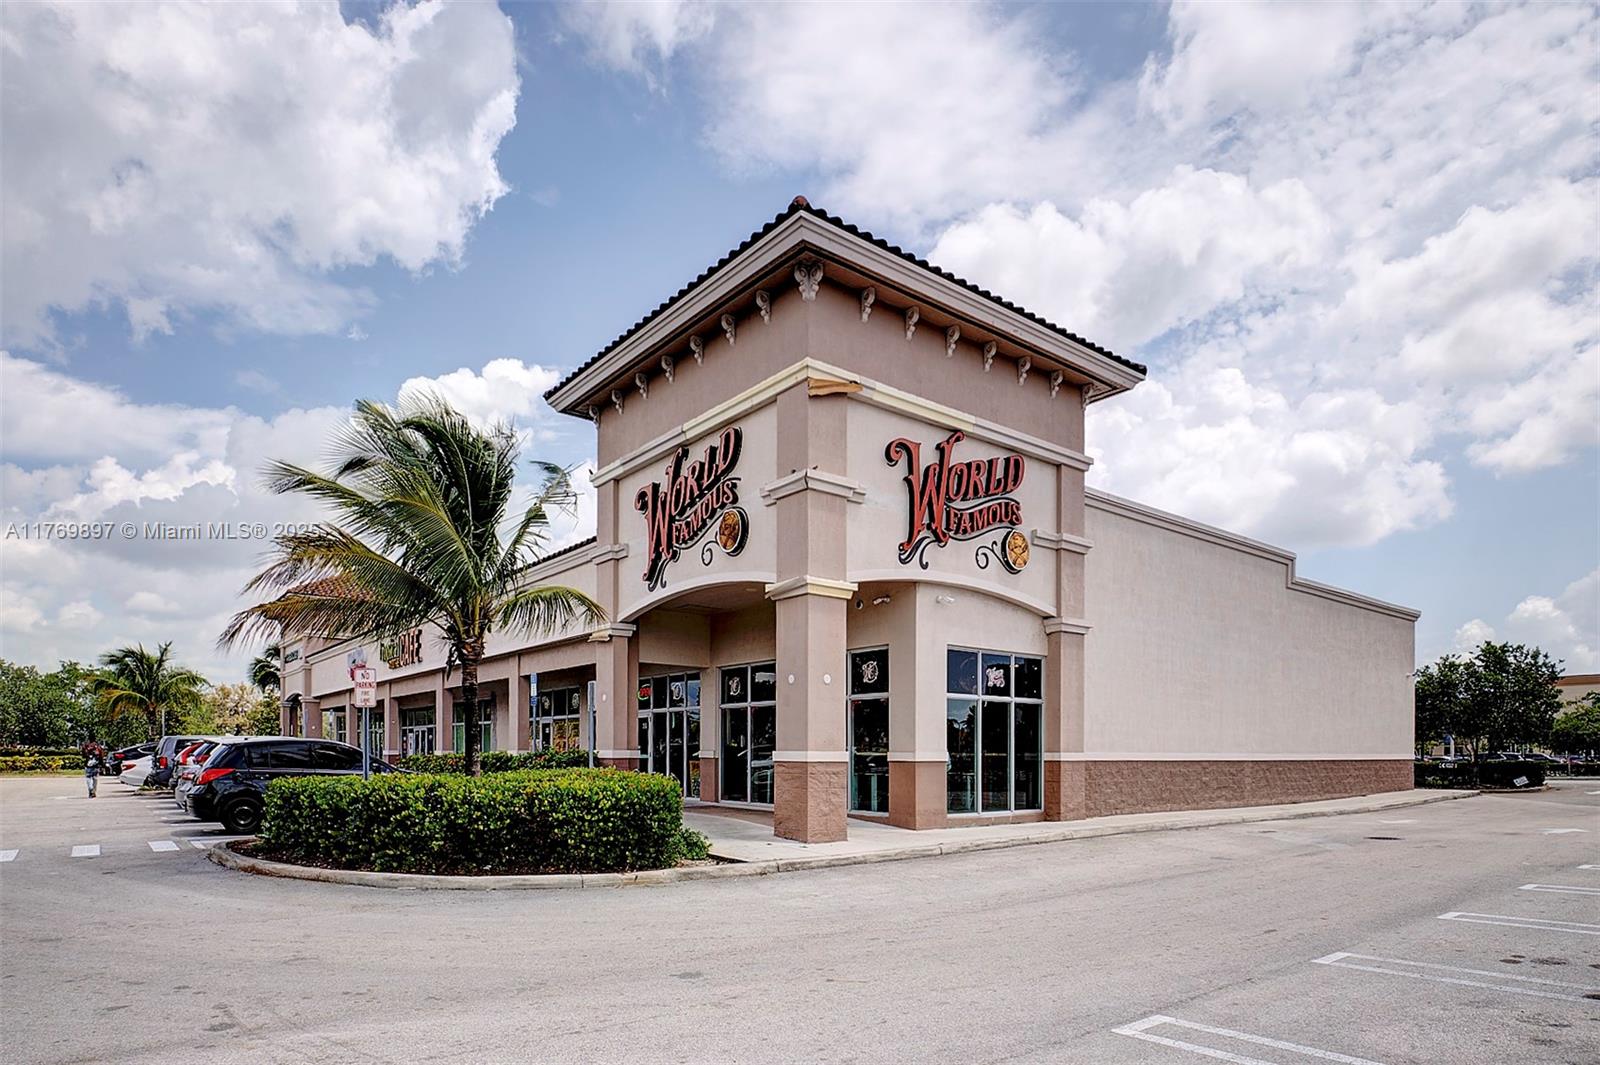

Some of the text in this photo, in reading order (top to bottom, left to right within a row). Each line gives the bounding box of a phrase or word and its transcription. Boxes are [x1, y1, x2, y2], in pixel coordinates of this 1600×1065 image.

[634, 427, 742, 588] WORLD
[672, 480, 738, 545] FAMOUS
[886, 431, 1025, 553] WORLD
[946, 501, 1023, 536] FAMOUS
